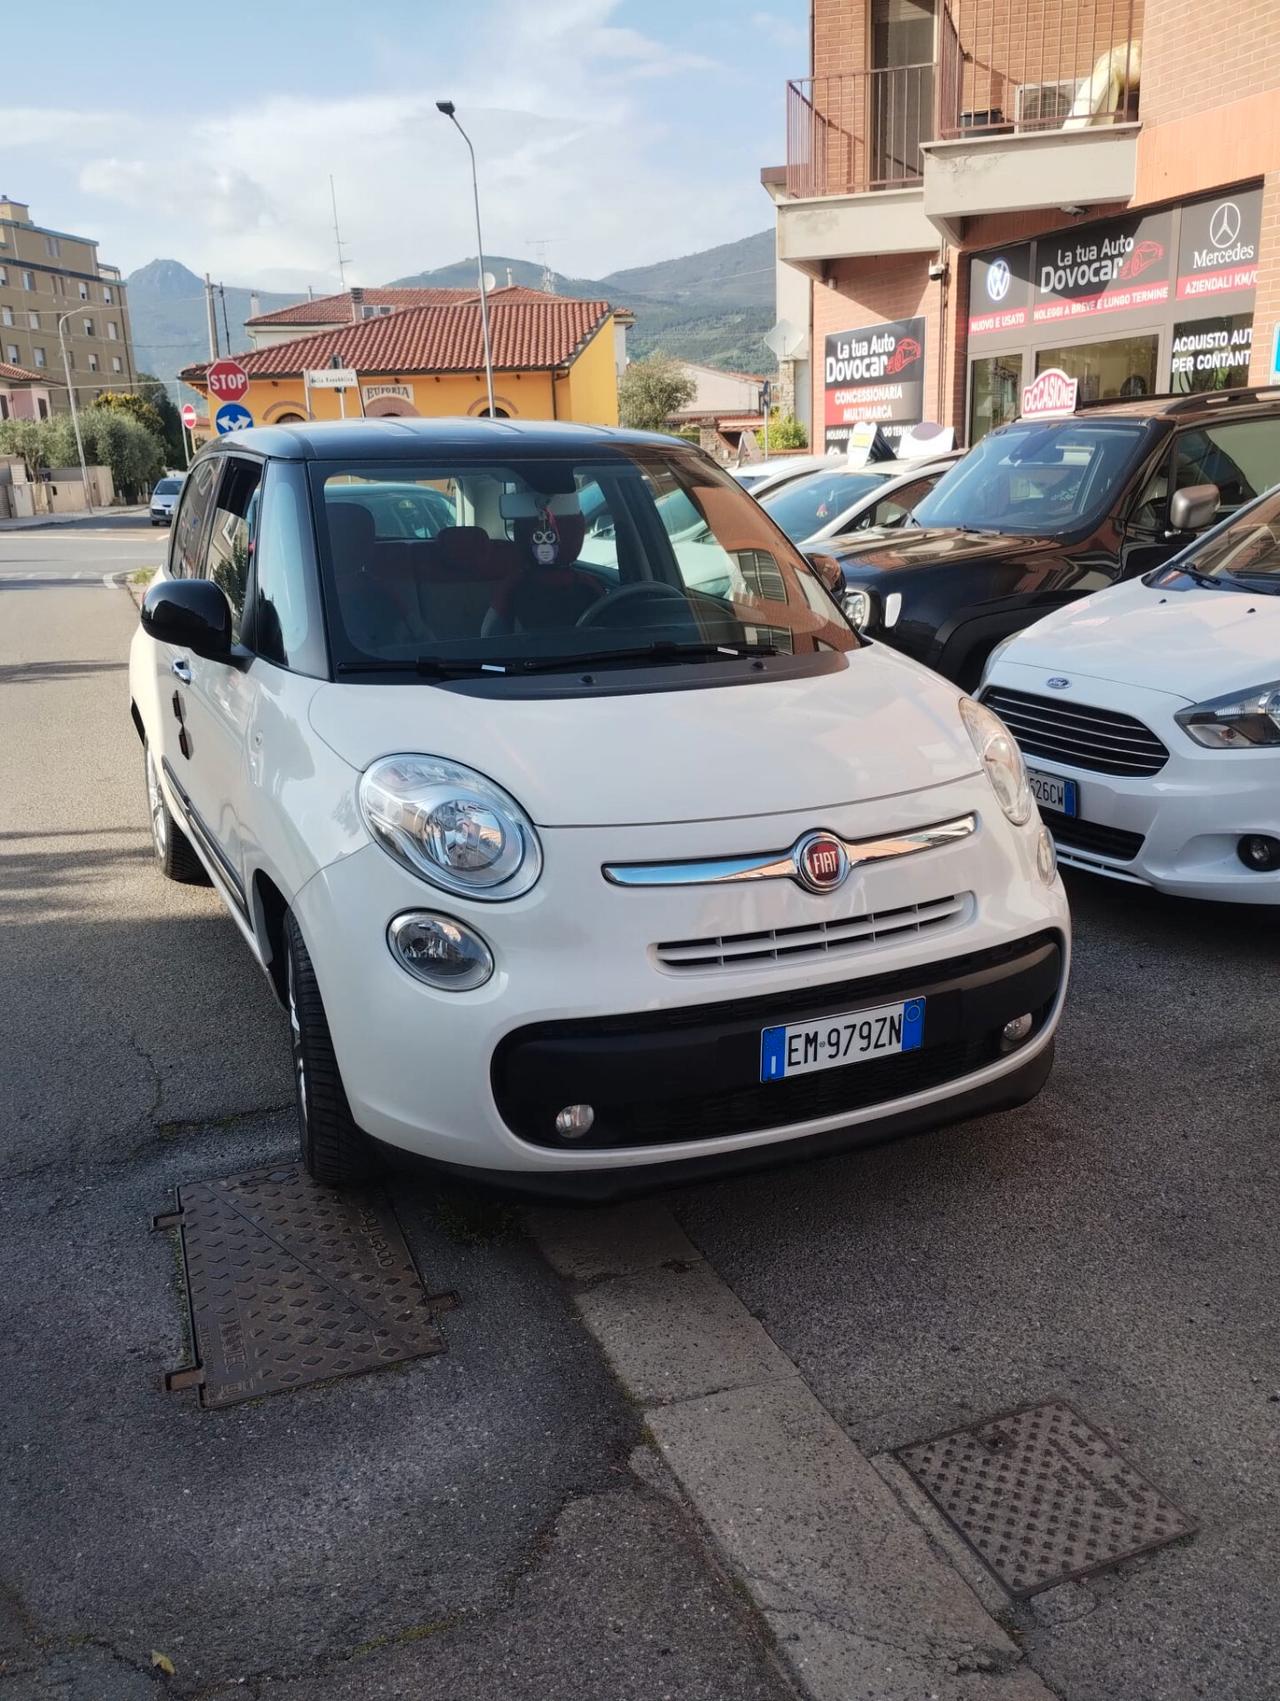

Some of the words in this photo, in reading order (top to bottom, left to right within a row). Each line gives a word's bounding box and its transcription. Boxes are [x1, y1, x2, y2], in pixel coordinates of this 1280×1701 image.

[1057, 249, 1072, 267] La
[1076, 244, 1097, 263] tua
[1100, 235, 1134, 258] Auto
[1193, 242, 1255, 269] Mercedes
[1040, 257, 1123, 293] Dovocar
[1184, 274, 1233, 295] AZIENDALI
[1034, 304, 1063, 321] NOLEGGI
[1064, 305, 1071, 316] A
[1072, 300, 1096, 314] BREVE
[1097, 298, 1104, 310] E
[1104, 294, 1131, 309] LUNGO
[1132, 286, 1169, 303] TERMINE
[971, 317, 994, 332] NUOVO
[995, 316, 1001, 328] E
[1001, 312, 1025, 327] USATO
[837, 341, 850, 360] La
[851, 338, 868, 357] tua
[869, 332, 896, 355] Auto
[1173, 331, 1229, 353] ACQUISTO
[826, 354, 889, 383] Dovocar
[1172, 356, 1194, 373] PER
[210, 373, 246, 390] STOP
[1024, 375, 1075, 412] OCCASIONE
[834, 385, 903, 405] CONCESSIONARIA
[843, 404, 892, 422] MULTIMARCA
[812, 850, 837, 875] FIAT
